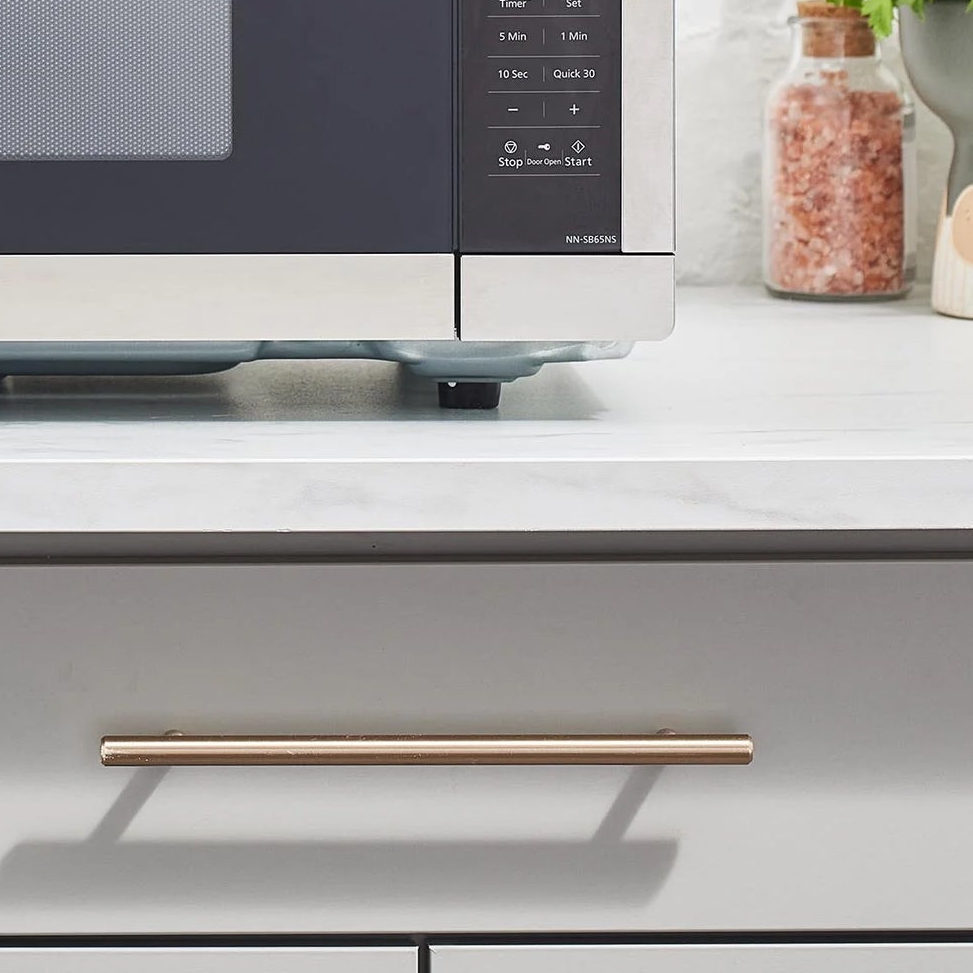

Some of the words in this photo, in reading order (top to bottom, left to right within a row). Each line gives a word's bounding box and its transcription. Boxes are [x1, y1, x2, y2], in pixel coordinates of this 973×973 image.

[500, 0, 527, 8] Timer
[566, 0, 582, 8] Set
[499, 33, 505, 41] 5
[508, 32, 527, 41] Min
[561, 33, 566, 41] 1
[569, 32, 587, 41] Min
[498, 70, 509, 78] 10
[512, 70, 528, 78] Sec
[553, 69, 581, 79] Quick
[583, 69, 595, 78] 30
[498, 157, 523, 168] Stop
[564, 157, 592, 167] Start
[566, 235, 617, 244] NN-SB65NS
